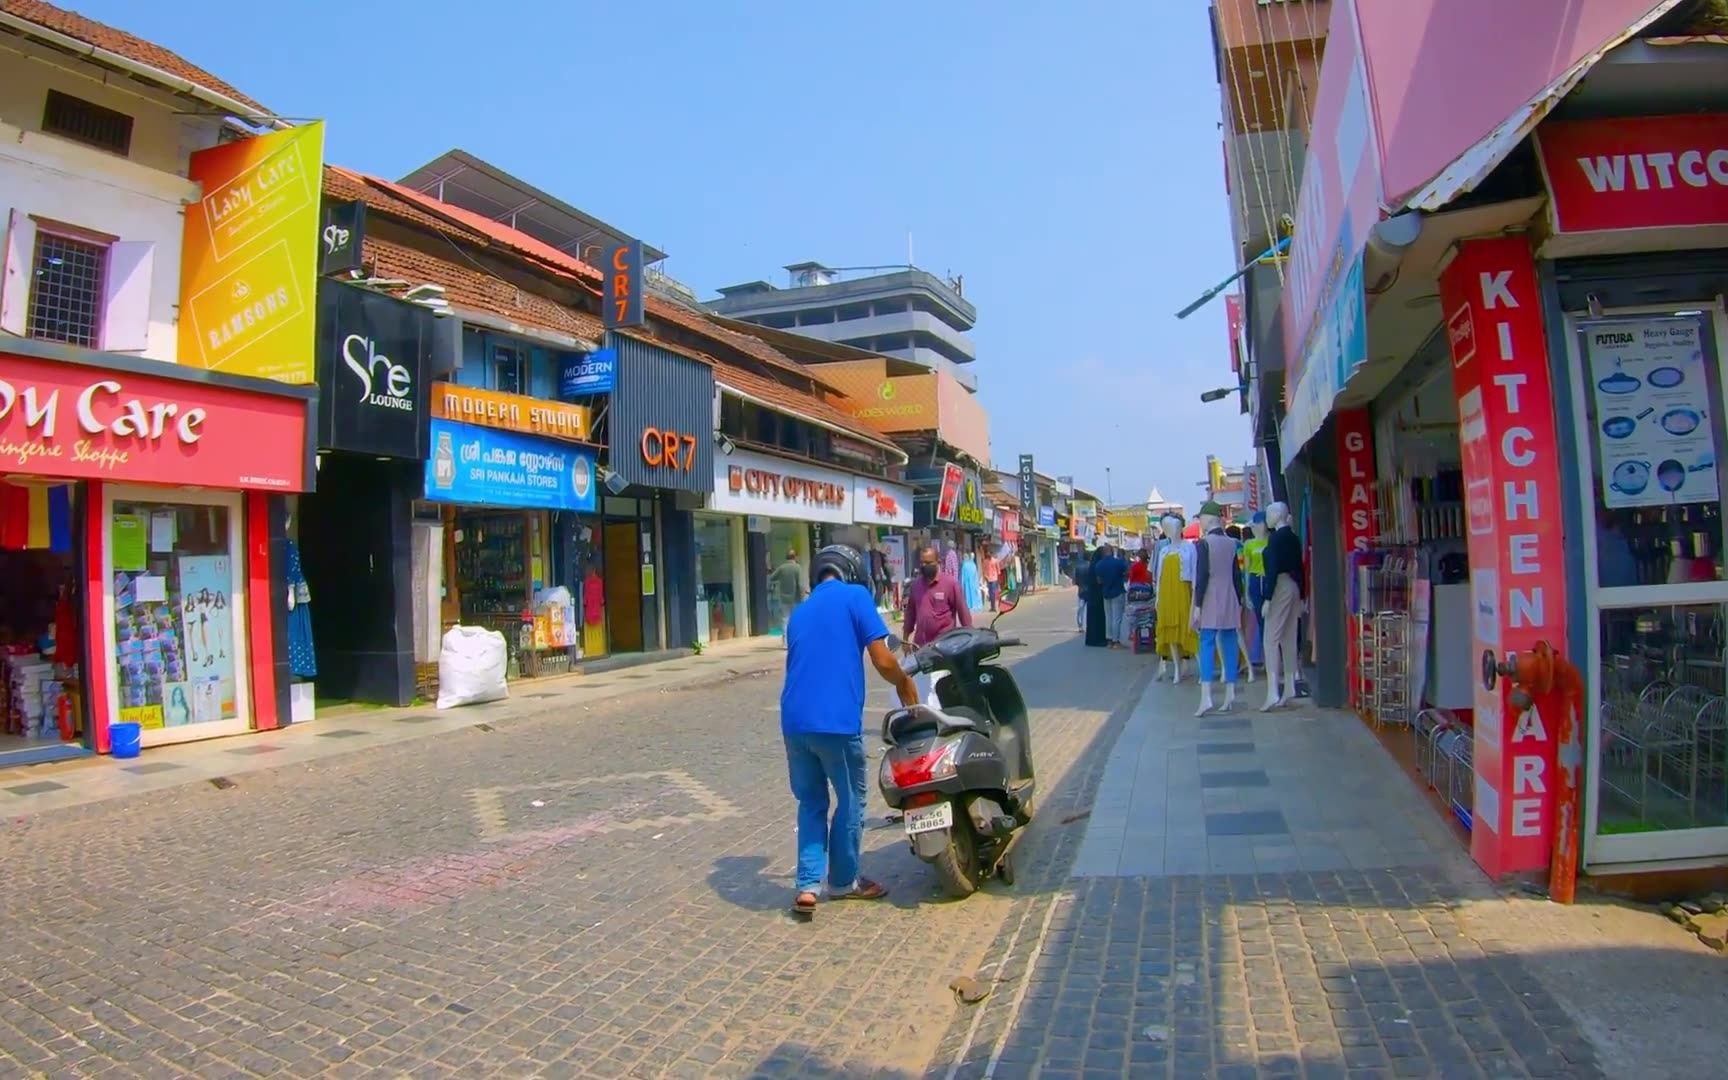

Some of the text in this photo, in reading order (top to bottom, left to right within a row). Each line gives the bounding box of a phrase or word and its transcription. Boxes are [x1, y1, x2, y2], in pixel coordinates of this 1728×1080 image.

[612, 246, 629, 322] CR7
[1596, 332, 1634, 345] FUTURA
[1643, 327, 1694, 339] Heavy Gauge
[343, 334, 411, 402] She
[563, 361, 613, 379] MODERN
[77, 380, 206, 444] Care
[370, 393, 413, 411] LOUNGE
[531, 406, 581, 428] STUDIO
[71, 439, 128, 470] Shoppe
[642, 426, 696, 471] CR7
[470, 467, 558, 488] SRI PANKAJA STORES
[745, 468, 781, 497] CITY
[783, 475, 845, 506] OPTICALS
[1023, 466, 1032, 508] GULLY
